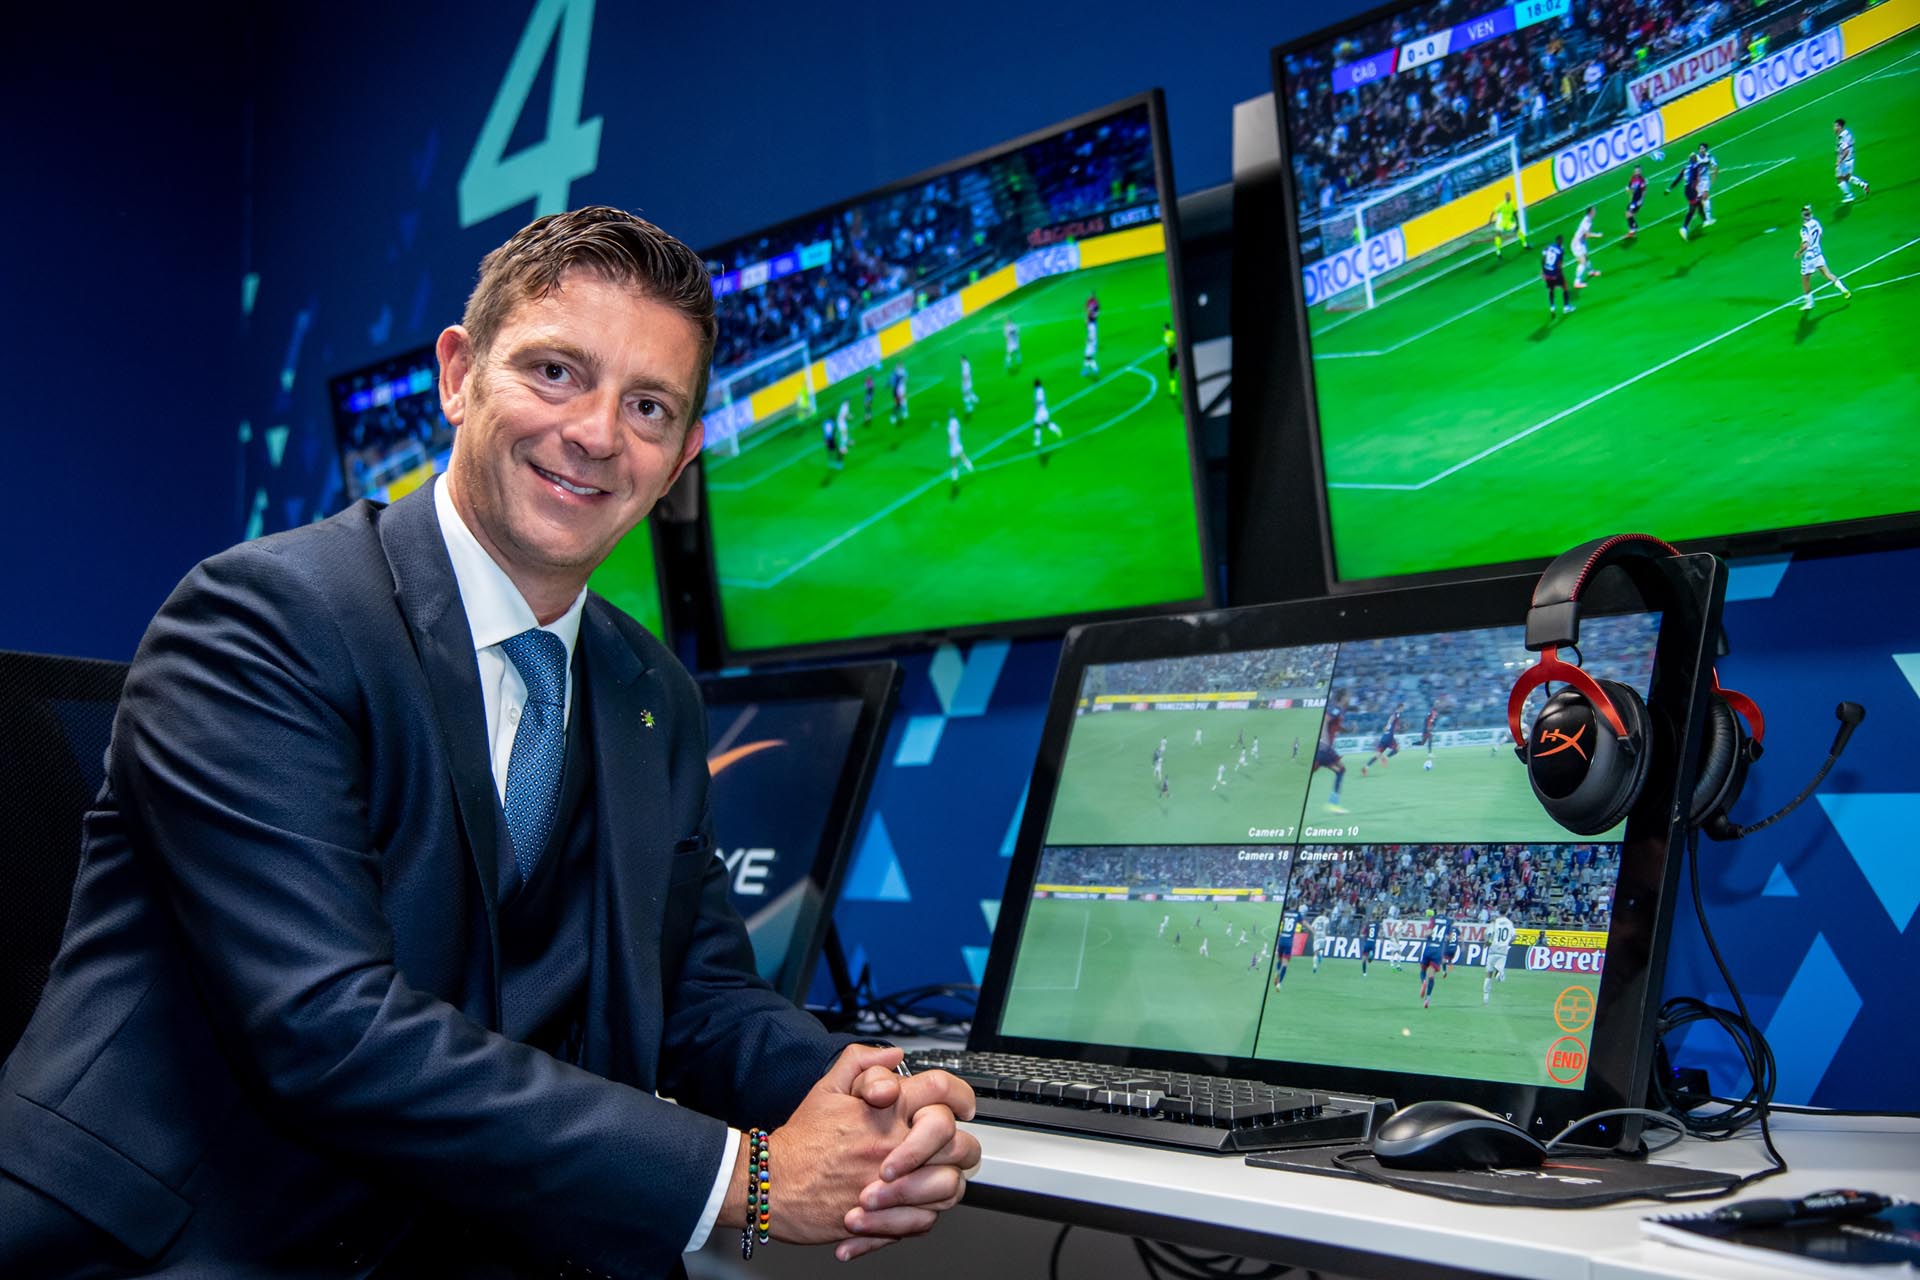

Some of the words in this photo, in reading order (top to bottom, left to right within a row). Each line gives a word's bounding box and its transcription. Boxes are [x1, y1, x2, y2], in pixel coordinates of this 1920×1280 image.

[1527, 0, 1562, 19] 18:02
[1467, 19, 1495, 41] VEN
[1351, 62, 1377, 83] CAG
[1629, 39, 1738, 104] WAMPUM
[458, 0, 603, 228] 4
[1248, 828, 1284, 837] Camera
[1287, 827, 1294, 837] 7
[1305, 827, 1344, 837] Camera
[1347, 826, 1359, 836] 10
[1238, 851, 1274, 861] Camera
[1278, 851, 1289, 861] 18
[1300, 850, 1339, 861] Camera
[1342, 850, 1353, 861] 11
[1431, 924, 1447, 942] 44
[1497, 927, 1509, 942] 10
[1515, 934, 1601, 948] PROSSIONAL
[1531, 945, 1605, 972] Beret
[1551, 1050, 1583, 1070] END
